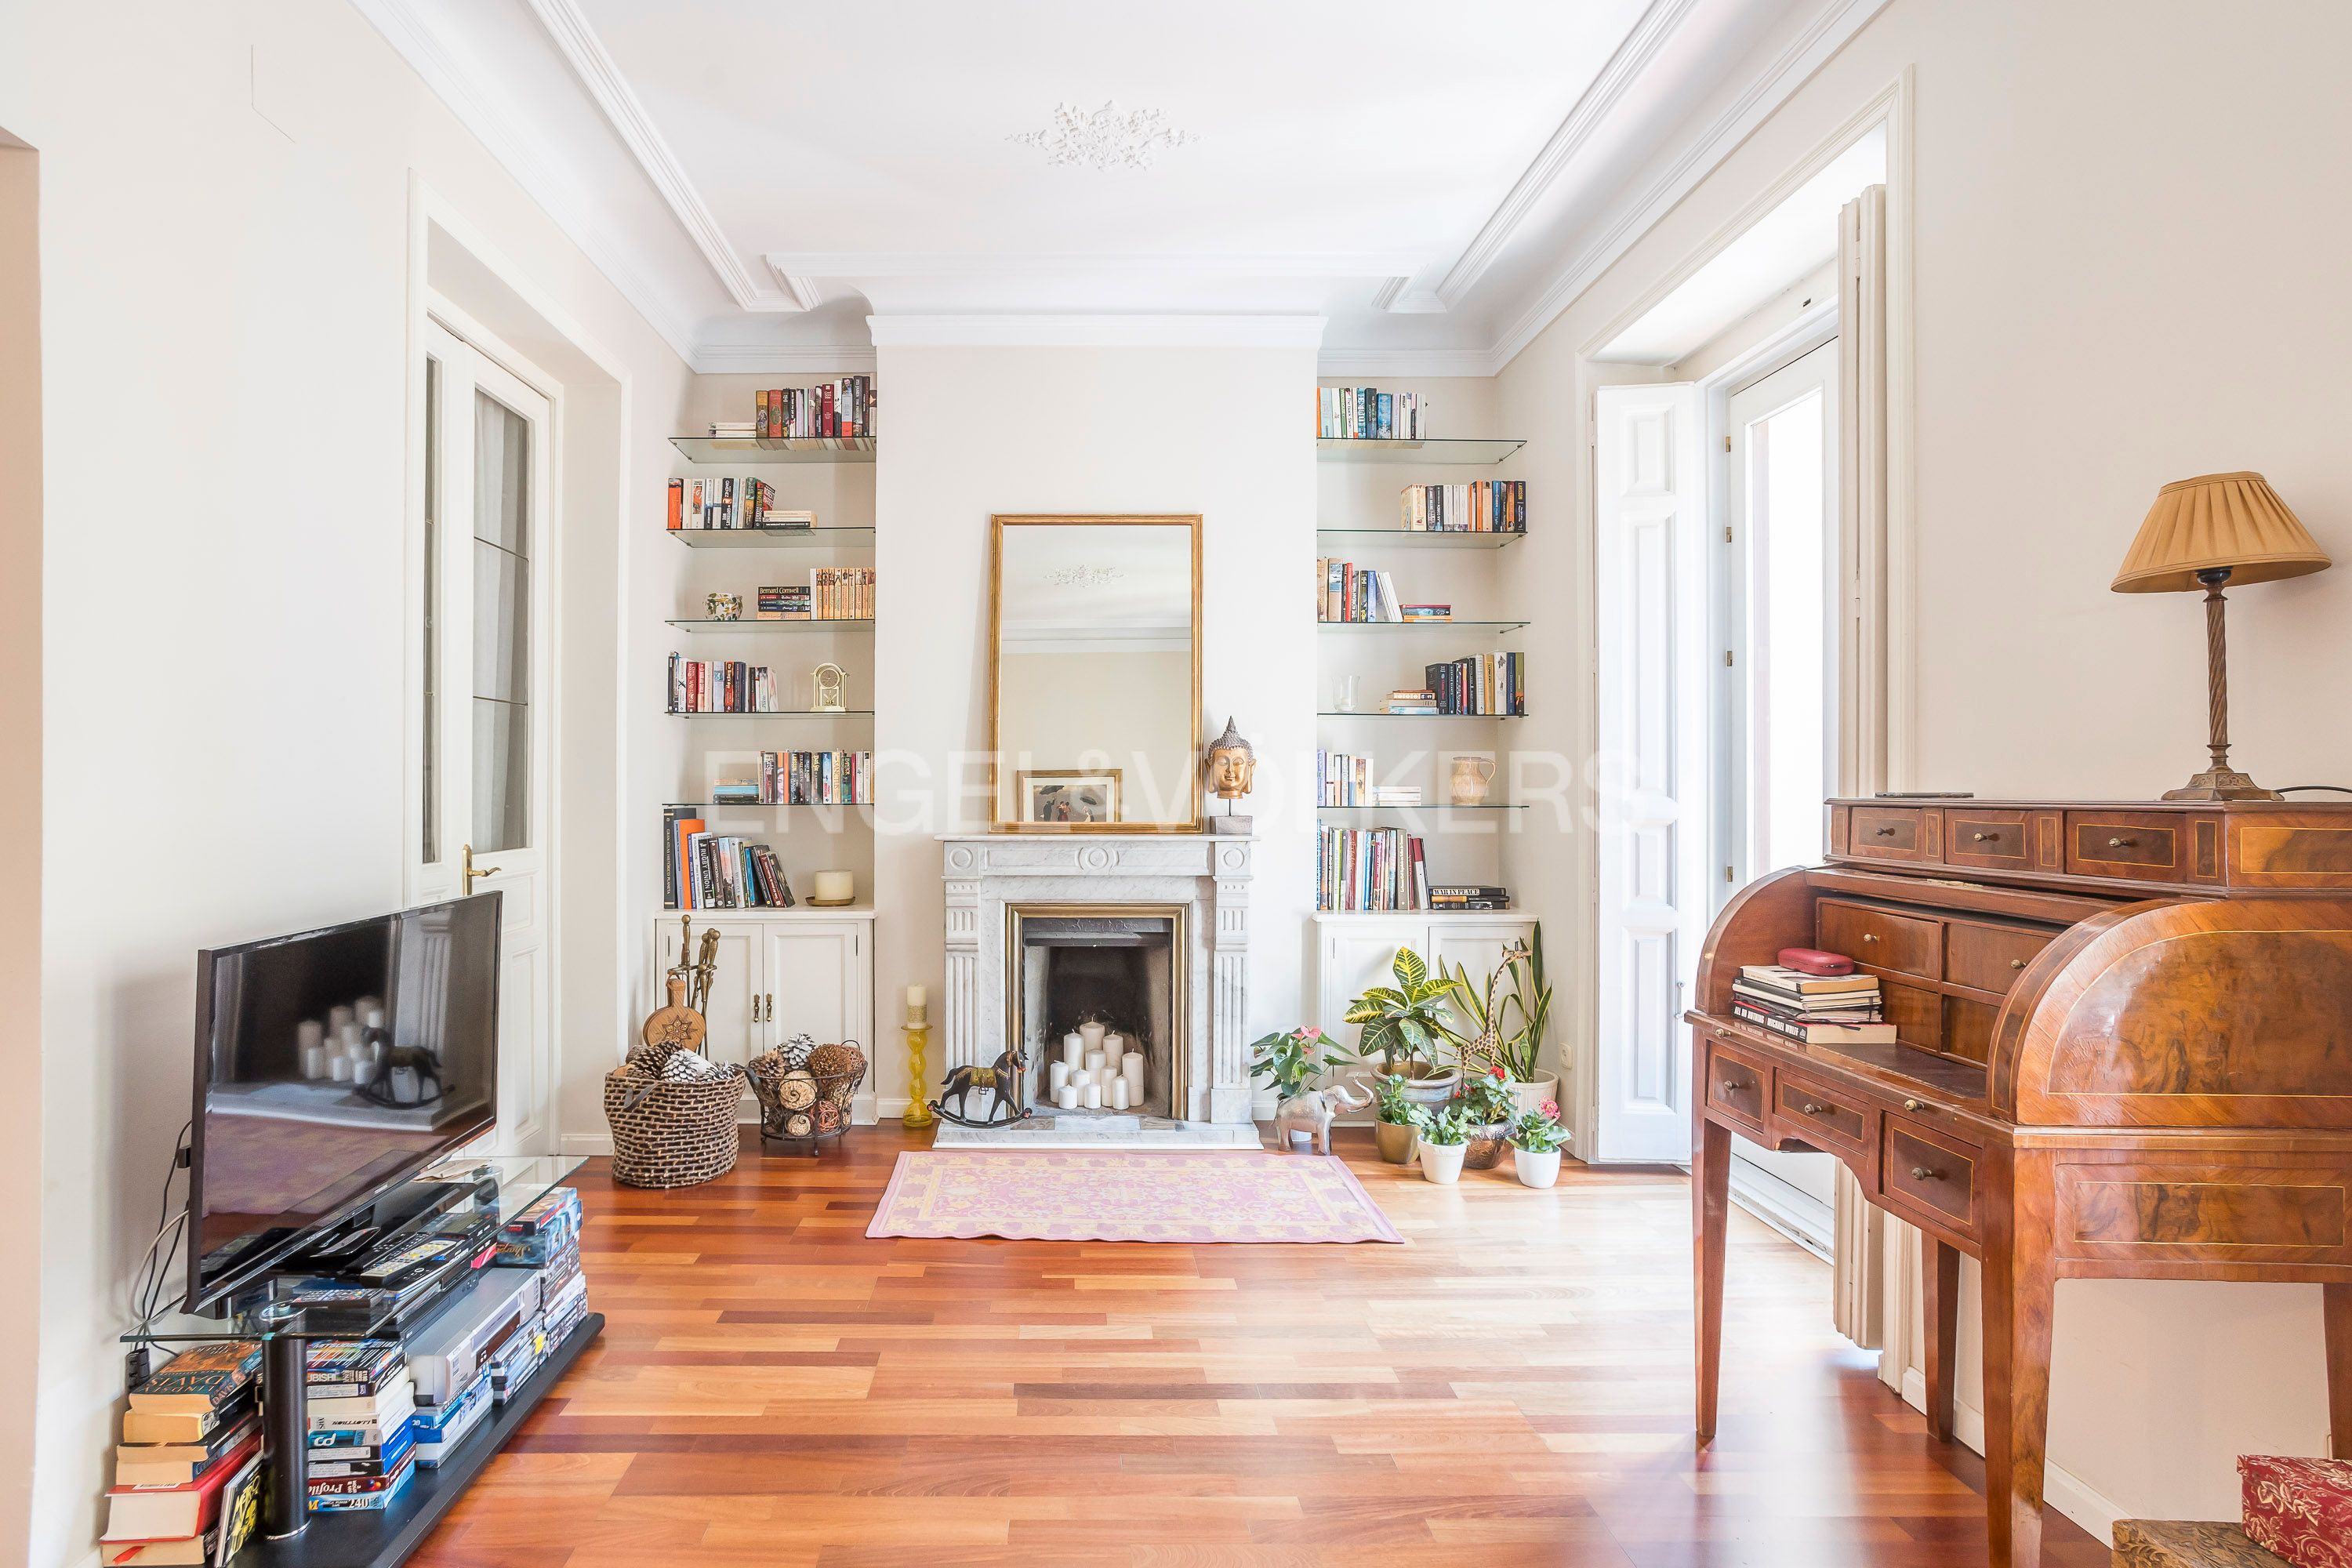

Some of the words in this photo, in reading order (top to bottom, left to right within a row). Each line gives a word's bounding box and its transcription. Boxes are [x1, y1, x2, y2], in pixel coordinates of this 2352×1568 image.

[1767, 1017, 1784, 1032] MICHAEL
[1784, 1023, 1799, 1036] WOLFF
[149, 1374, 226, 1385] DAVIS
[349, 1498, 369, 1509] 240
